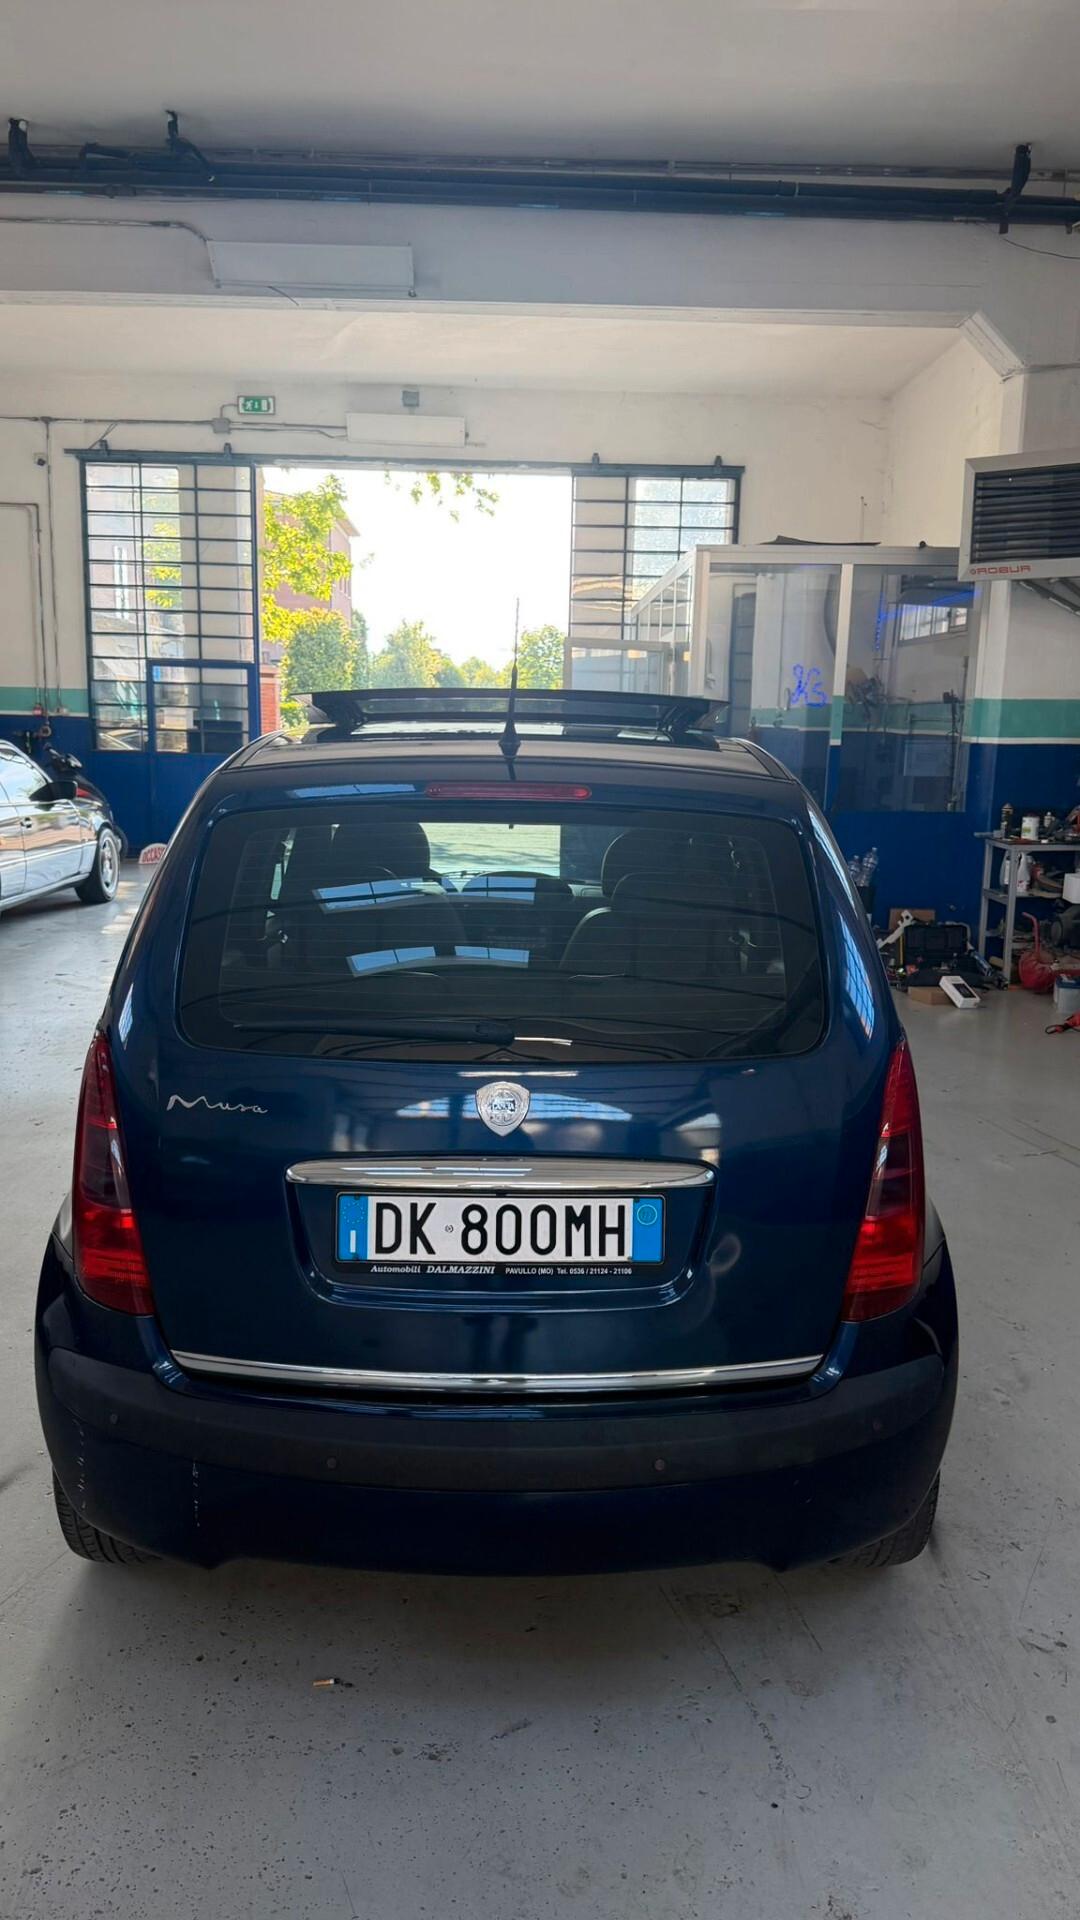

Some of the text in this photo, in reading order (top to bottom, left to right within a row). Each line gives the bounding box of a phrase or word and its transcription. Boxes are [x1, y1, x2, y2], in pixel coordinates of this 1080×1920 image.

[975, 565, 1031, 575] ROBUR
[166, 1094, 268, 1114] Musa
[374, 1201, 626, 1257] DK 800MH
[370, 1265, 421, 1274] Automobili
[426, 1265, 496, 1275] DALMAZZINI
[505, 1267, 537, 1275] PAVULLO
[537, 1267, 554, 1276] (MO)
[557, 1267, 568, 1275] Tel.
